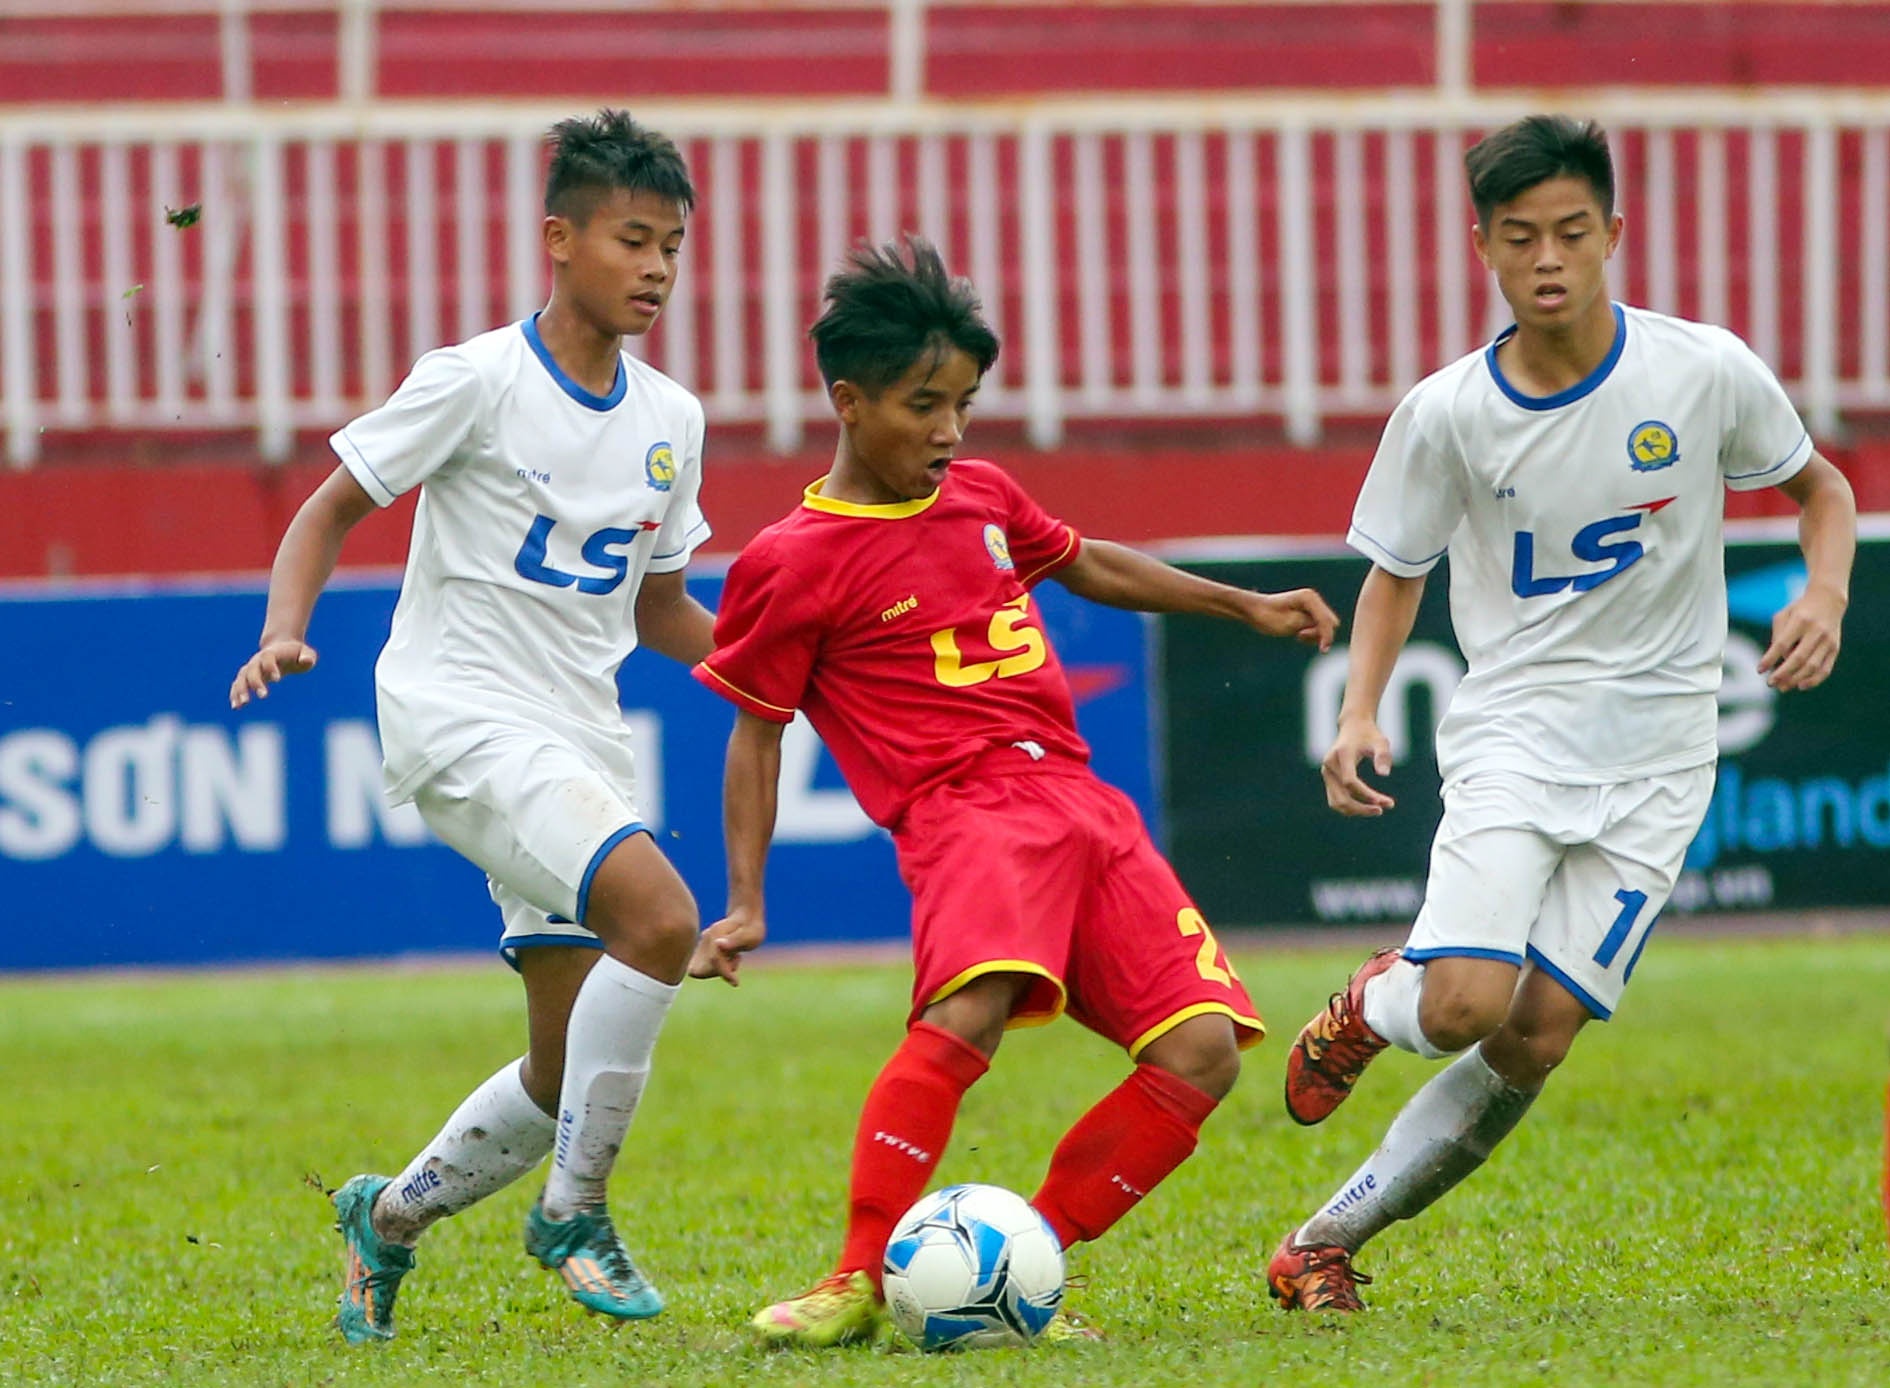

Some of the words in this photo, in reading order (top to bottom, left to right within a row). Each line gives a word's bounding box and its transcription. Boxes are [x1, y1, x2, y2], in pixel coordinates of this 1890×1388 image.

[514, 514, 637, 596] LS
[1511, 512, 1644, 598] LS
[930, 608, 1047, 687] LS
[1176, 907, 1241, 989] 2
[1592, 888, 1664, 986] 1
[401, 1168, 441, 1204] mitre
[1327, 1174, 1377, 1216] mitre
